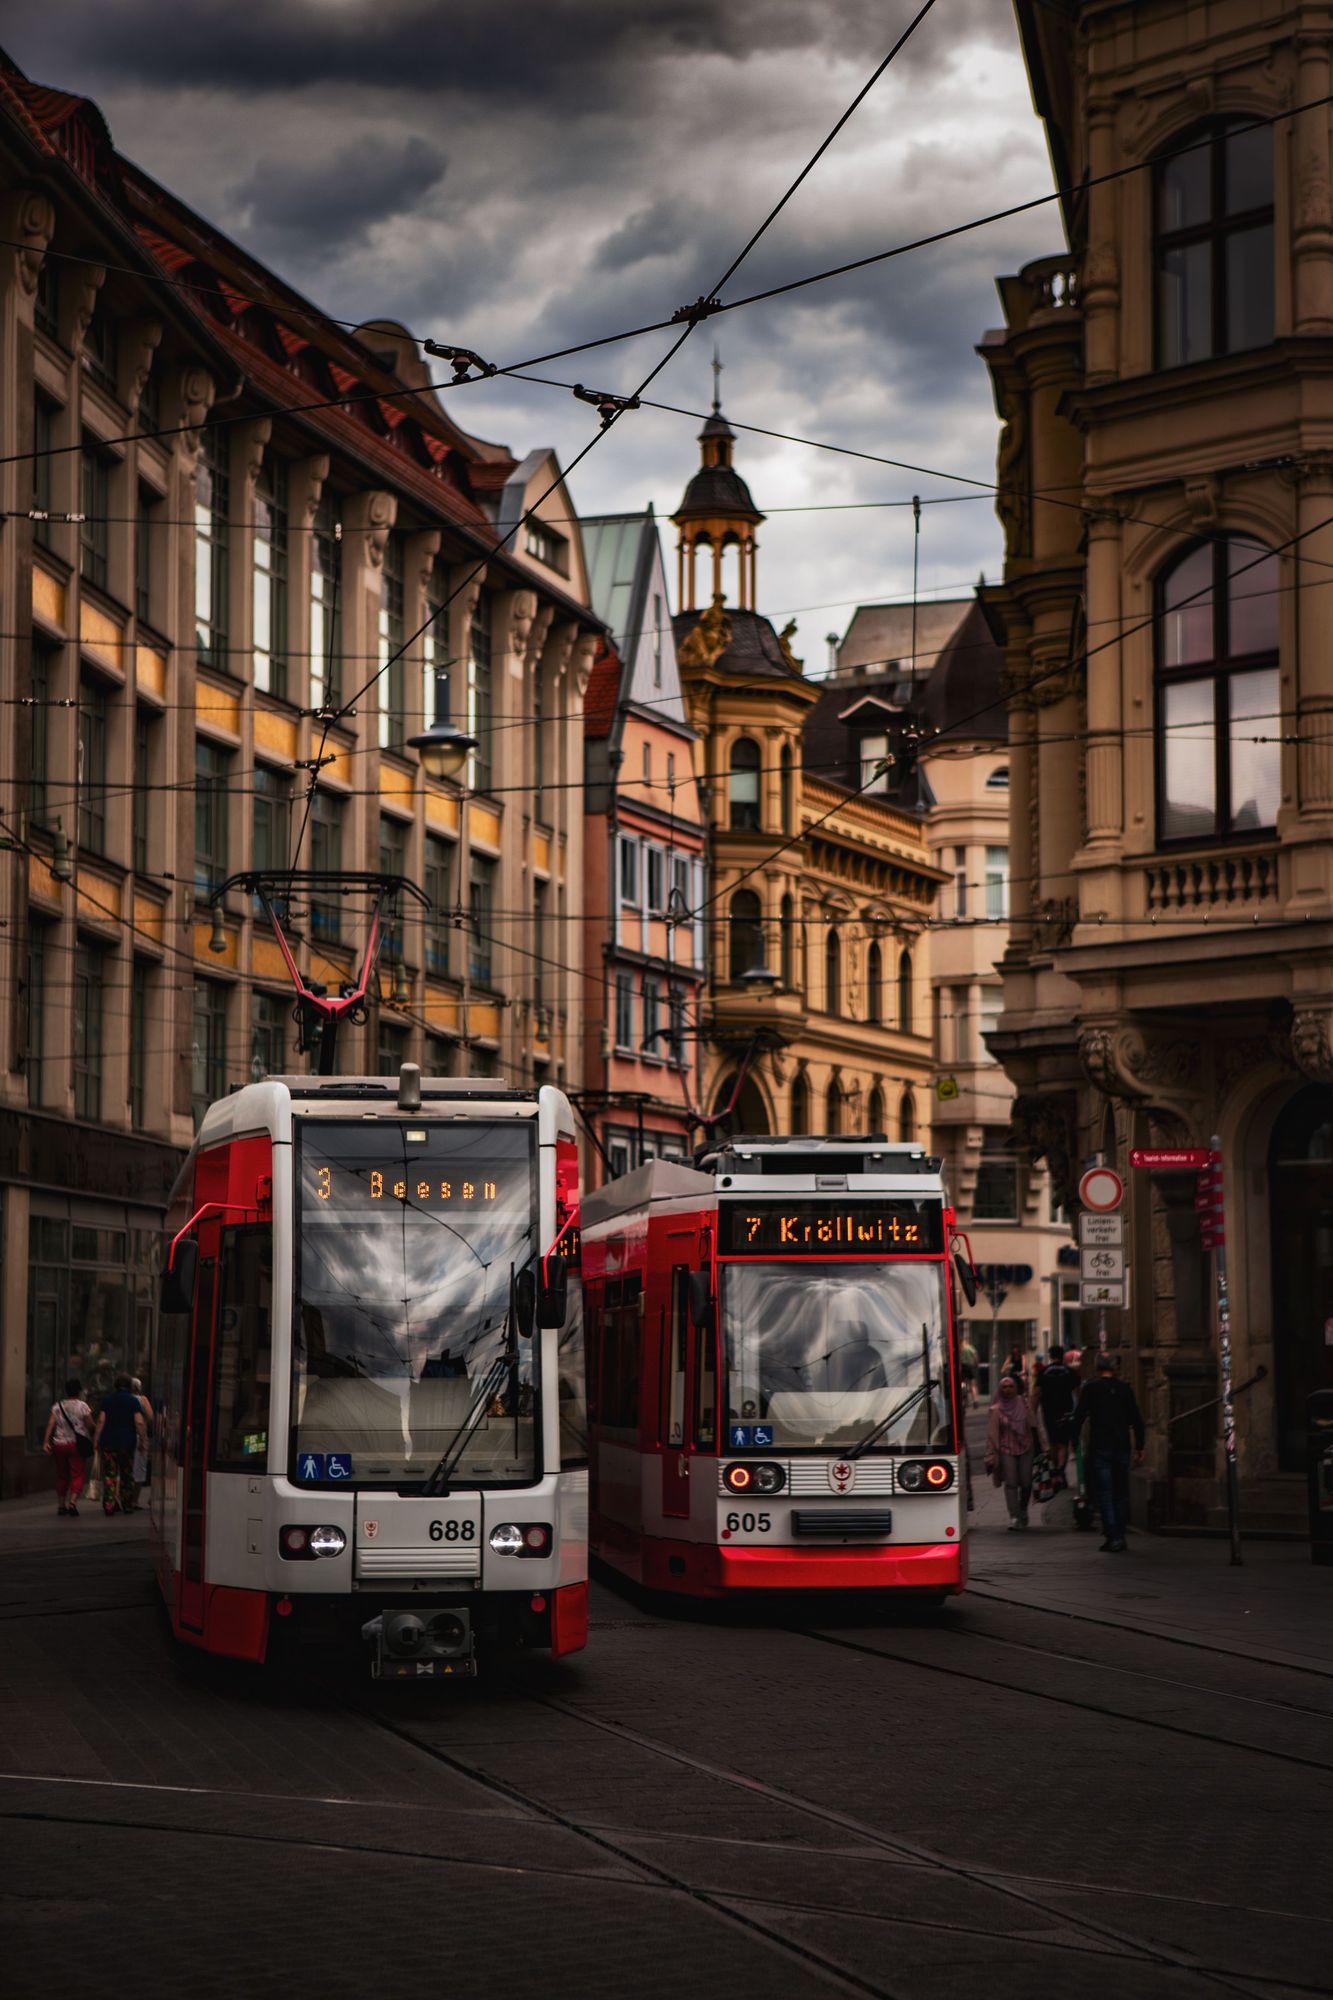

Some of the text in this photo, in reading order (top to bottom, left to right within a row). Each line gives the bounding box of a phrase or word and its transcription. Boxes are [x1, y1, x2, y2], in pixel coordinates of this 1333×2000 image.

[318, 1167, 497, 1200] 3 Beesen
[746, 1216, 919, 1242] 7 Kröllwitz
[1087, 1217, 1116, 1226] Linien-
[1086, 1226, 1117, 1234] verkehr
[1095, 1234, 1109, 1242] frei
[1095, 1269, 1110, 1277] frei
[429, 1519, 475, 1541] 688
[727, 1512, 771, 1533] 605
